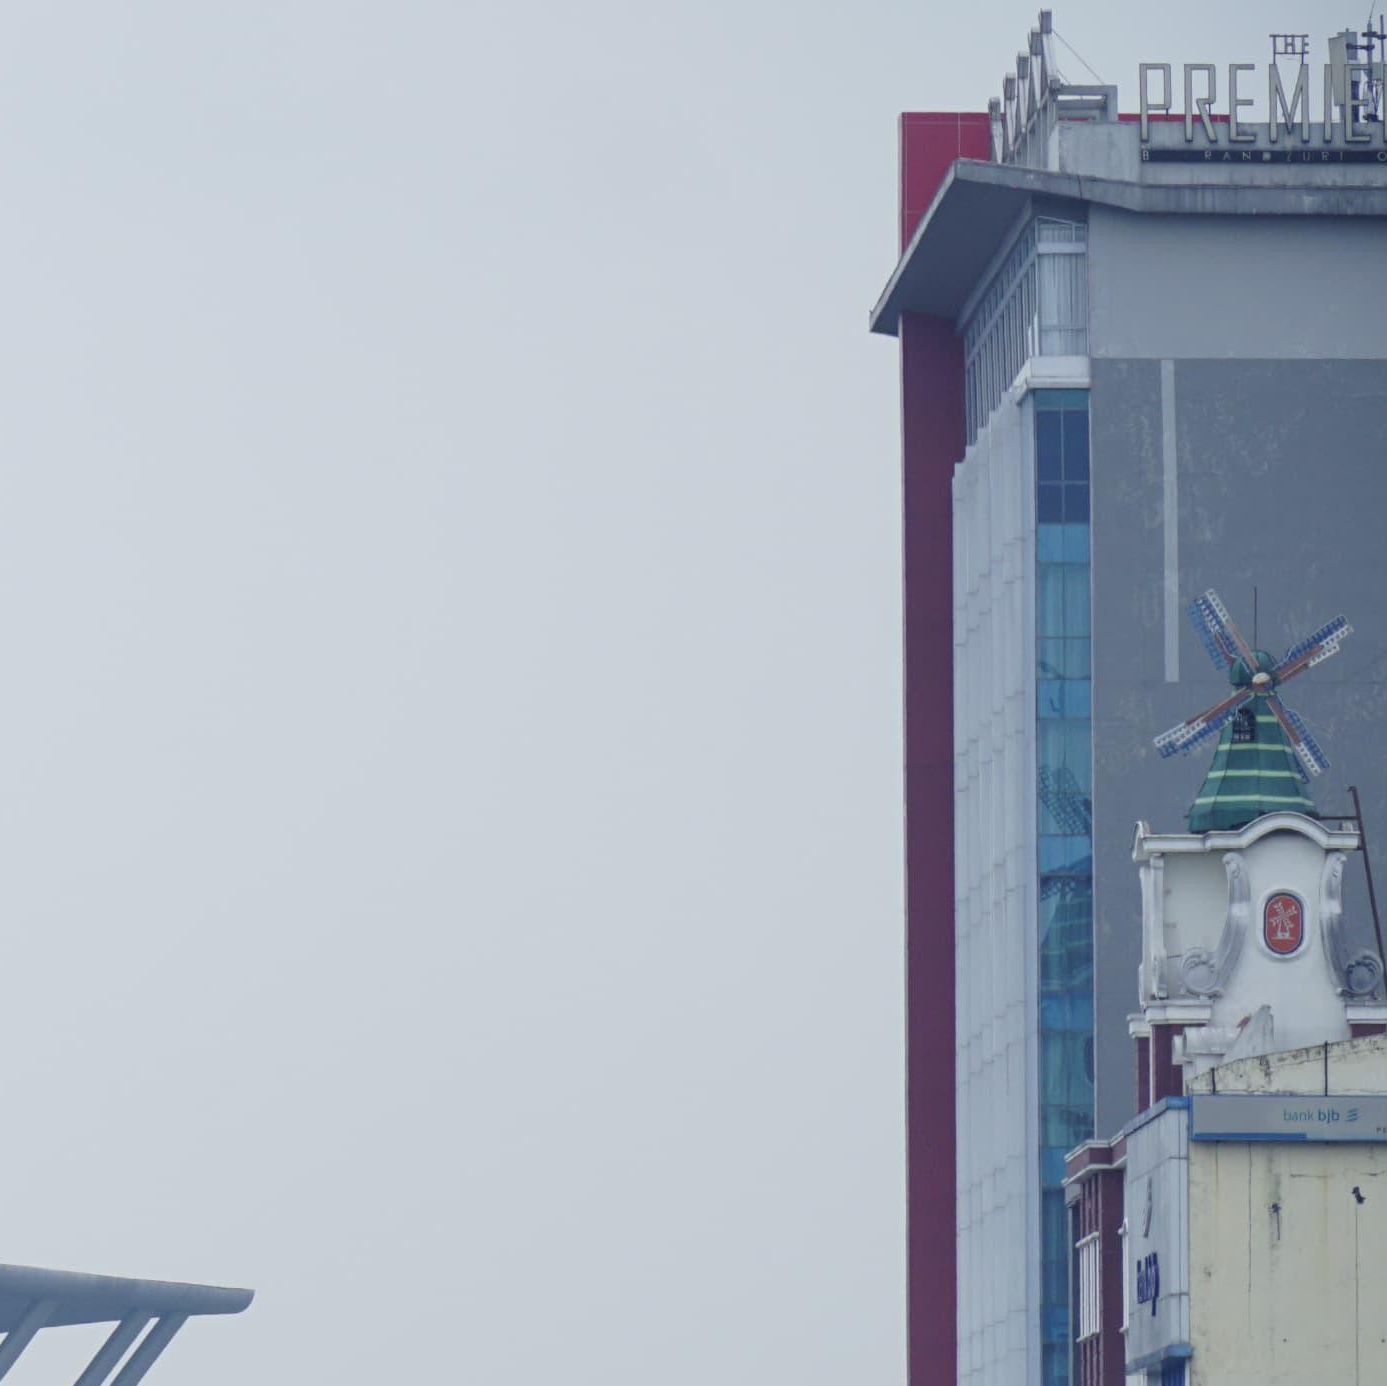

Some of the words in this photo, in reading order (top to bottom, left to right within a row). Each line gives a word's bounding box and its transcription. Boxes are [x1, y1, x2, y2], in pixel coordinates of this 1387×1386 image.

[1269, 34, 1309, 54] THE
[1139, 62, 1387, 143] PREMIE
[1283, 1108, 1314, 1121] bank
[1318, 1108, 1340, 1124] bjb
